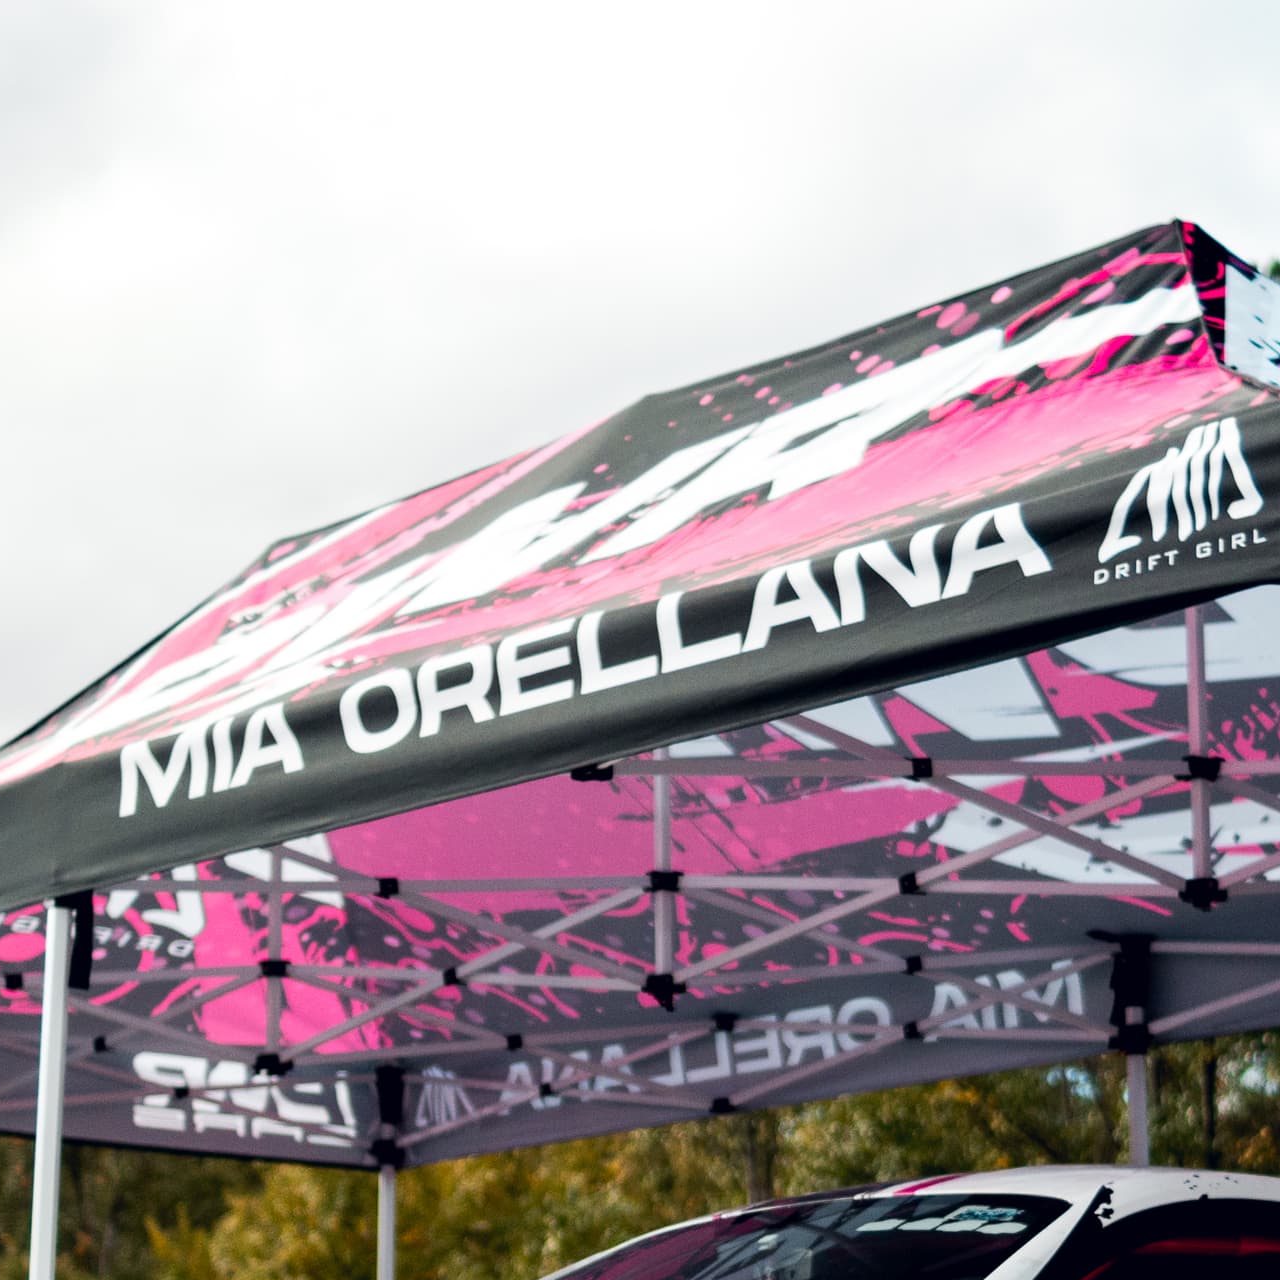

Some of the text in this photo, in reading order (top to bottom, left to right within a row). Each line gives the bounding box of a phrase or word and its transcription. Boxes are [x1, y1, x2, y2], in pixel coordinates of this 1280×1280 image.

[1093, 528, 1267, 586] DRIFT GIRL
[118, 502, 1054, 818] MIA ORELLANA
